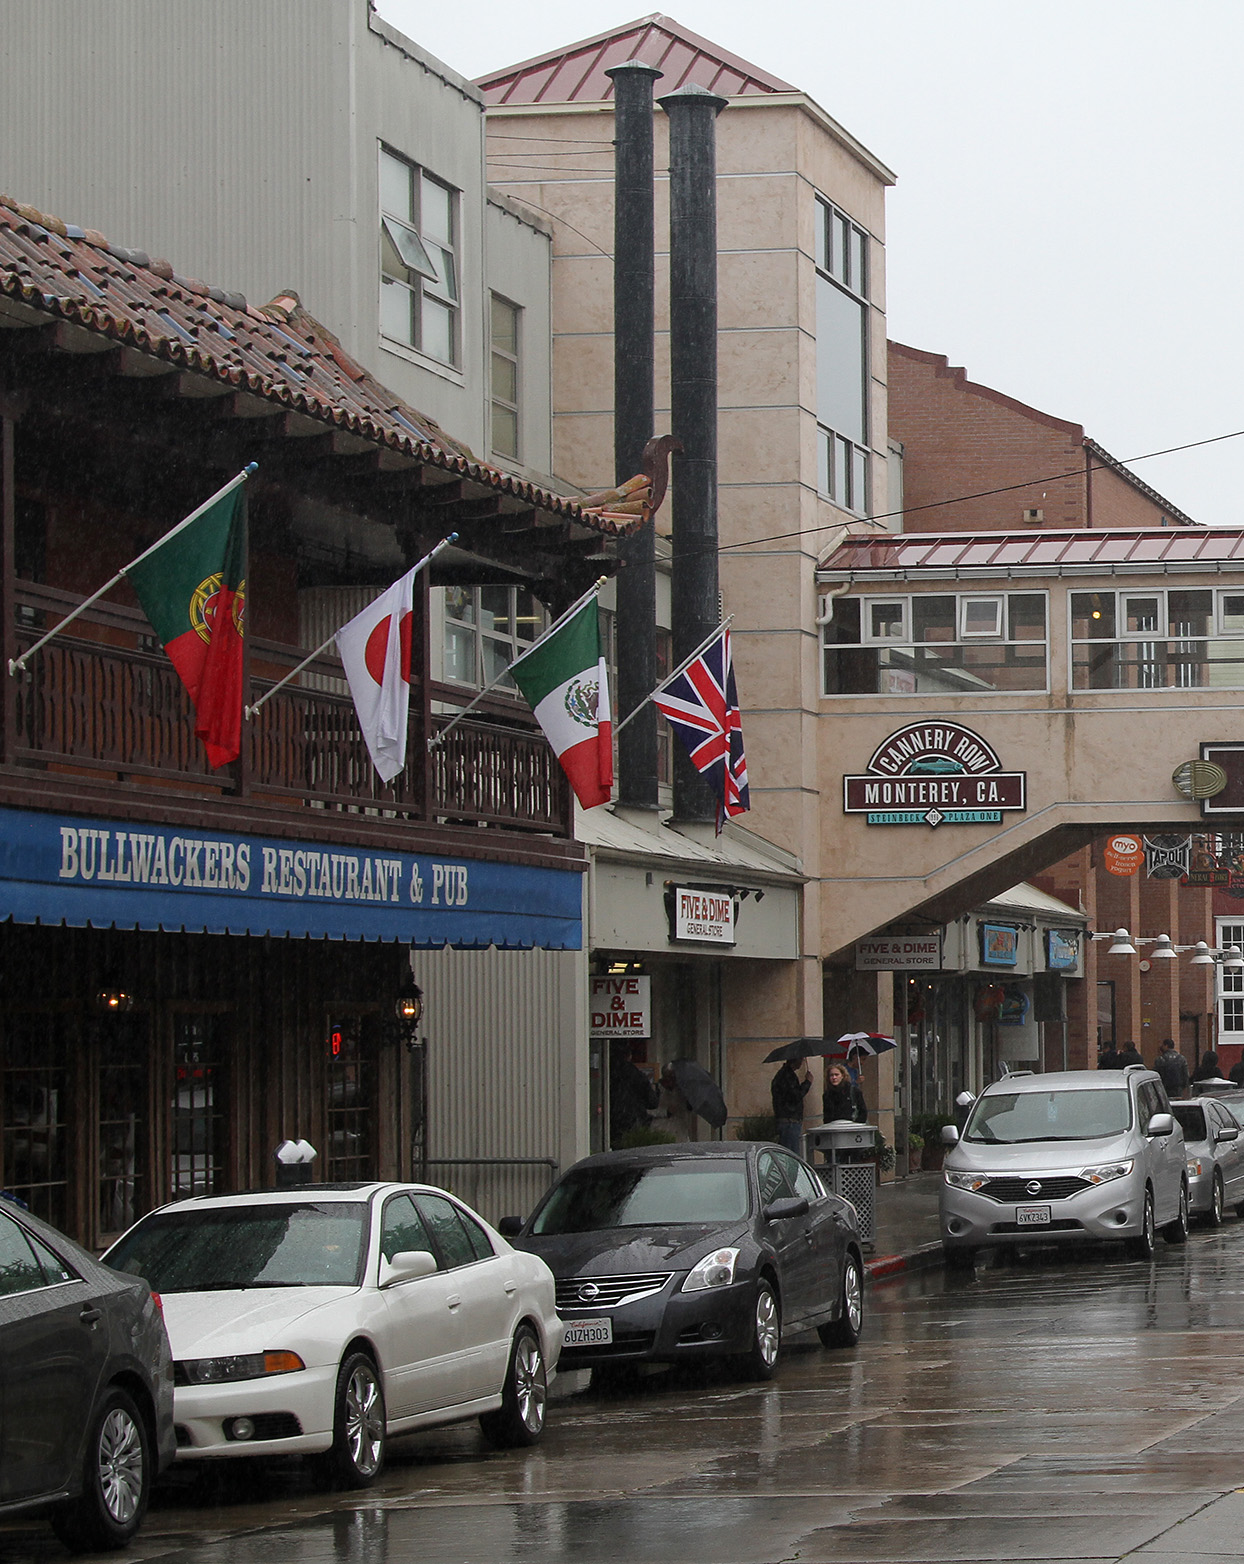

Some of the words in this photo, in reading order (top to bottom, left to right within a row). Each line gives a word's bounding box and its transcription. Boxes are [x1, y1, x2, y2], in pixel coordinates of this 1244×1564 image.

[879, 729, 955, 773] CANNERY
[953, 736, 990, 772] ROW
[865, 781, 968, 805] MONTEREY,
[976, 781, 1006, 802] CA.
[870, 813, 921, 824] STEINBECK
[948, 812, 976, 821] PLAZA
[979, 811, 999, 821] ONE
[1114, 841, 1136, 852] myo
[59, 827, 250, 892] BULLWACKERS
[261, 847, 403, 902] RESTAURANT
[409, 862, 423, 903] &
[431, 864, 468, 906] PUB
[1110, 865, 1132, 873] yogurt
[681, 894, 700, 919] FIVE
[702, 897, 708, 920] &
[709, 898, 730, 923] DIME
[687, 922, 709, 935] GENERAL
[709, 925, 723, 937] STORE
[860, 943, 889, 954] FIVE
[891, 943, 901, 954] &
[904, 943, 937, 953] DIME
[863, 957, 904, 965] GENERAL
[592, 978, 639, 995] FIVE
[611, 995, 626, 1011] &
[591, 1012, 643, 1028] DIME
[564, 1328, 609, 1343] 6UZH303
